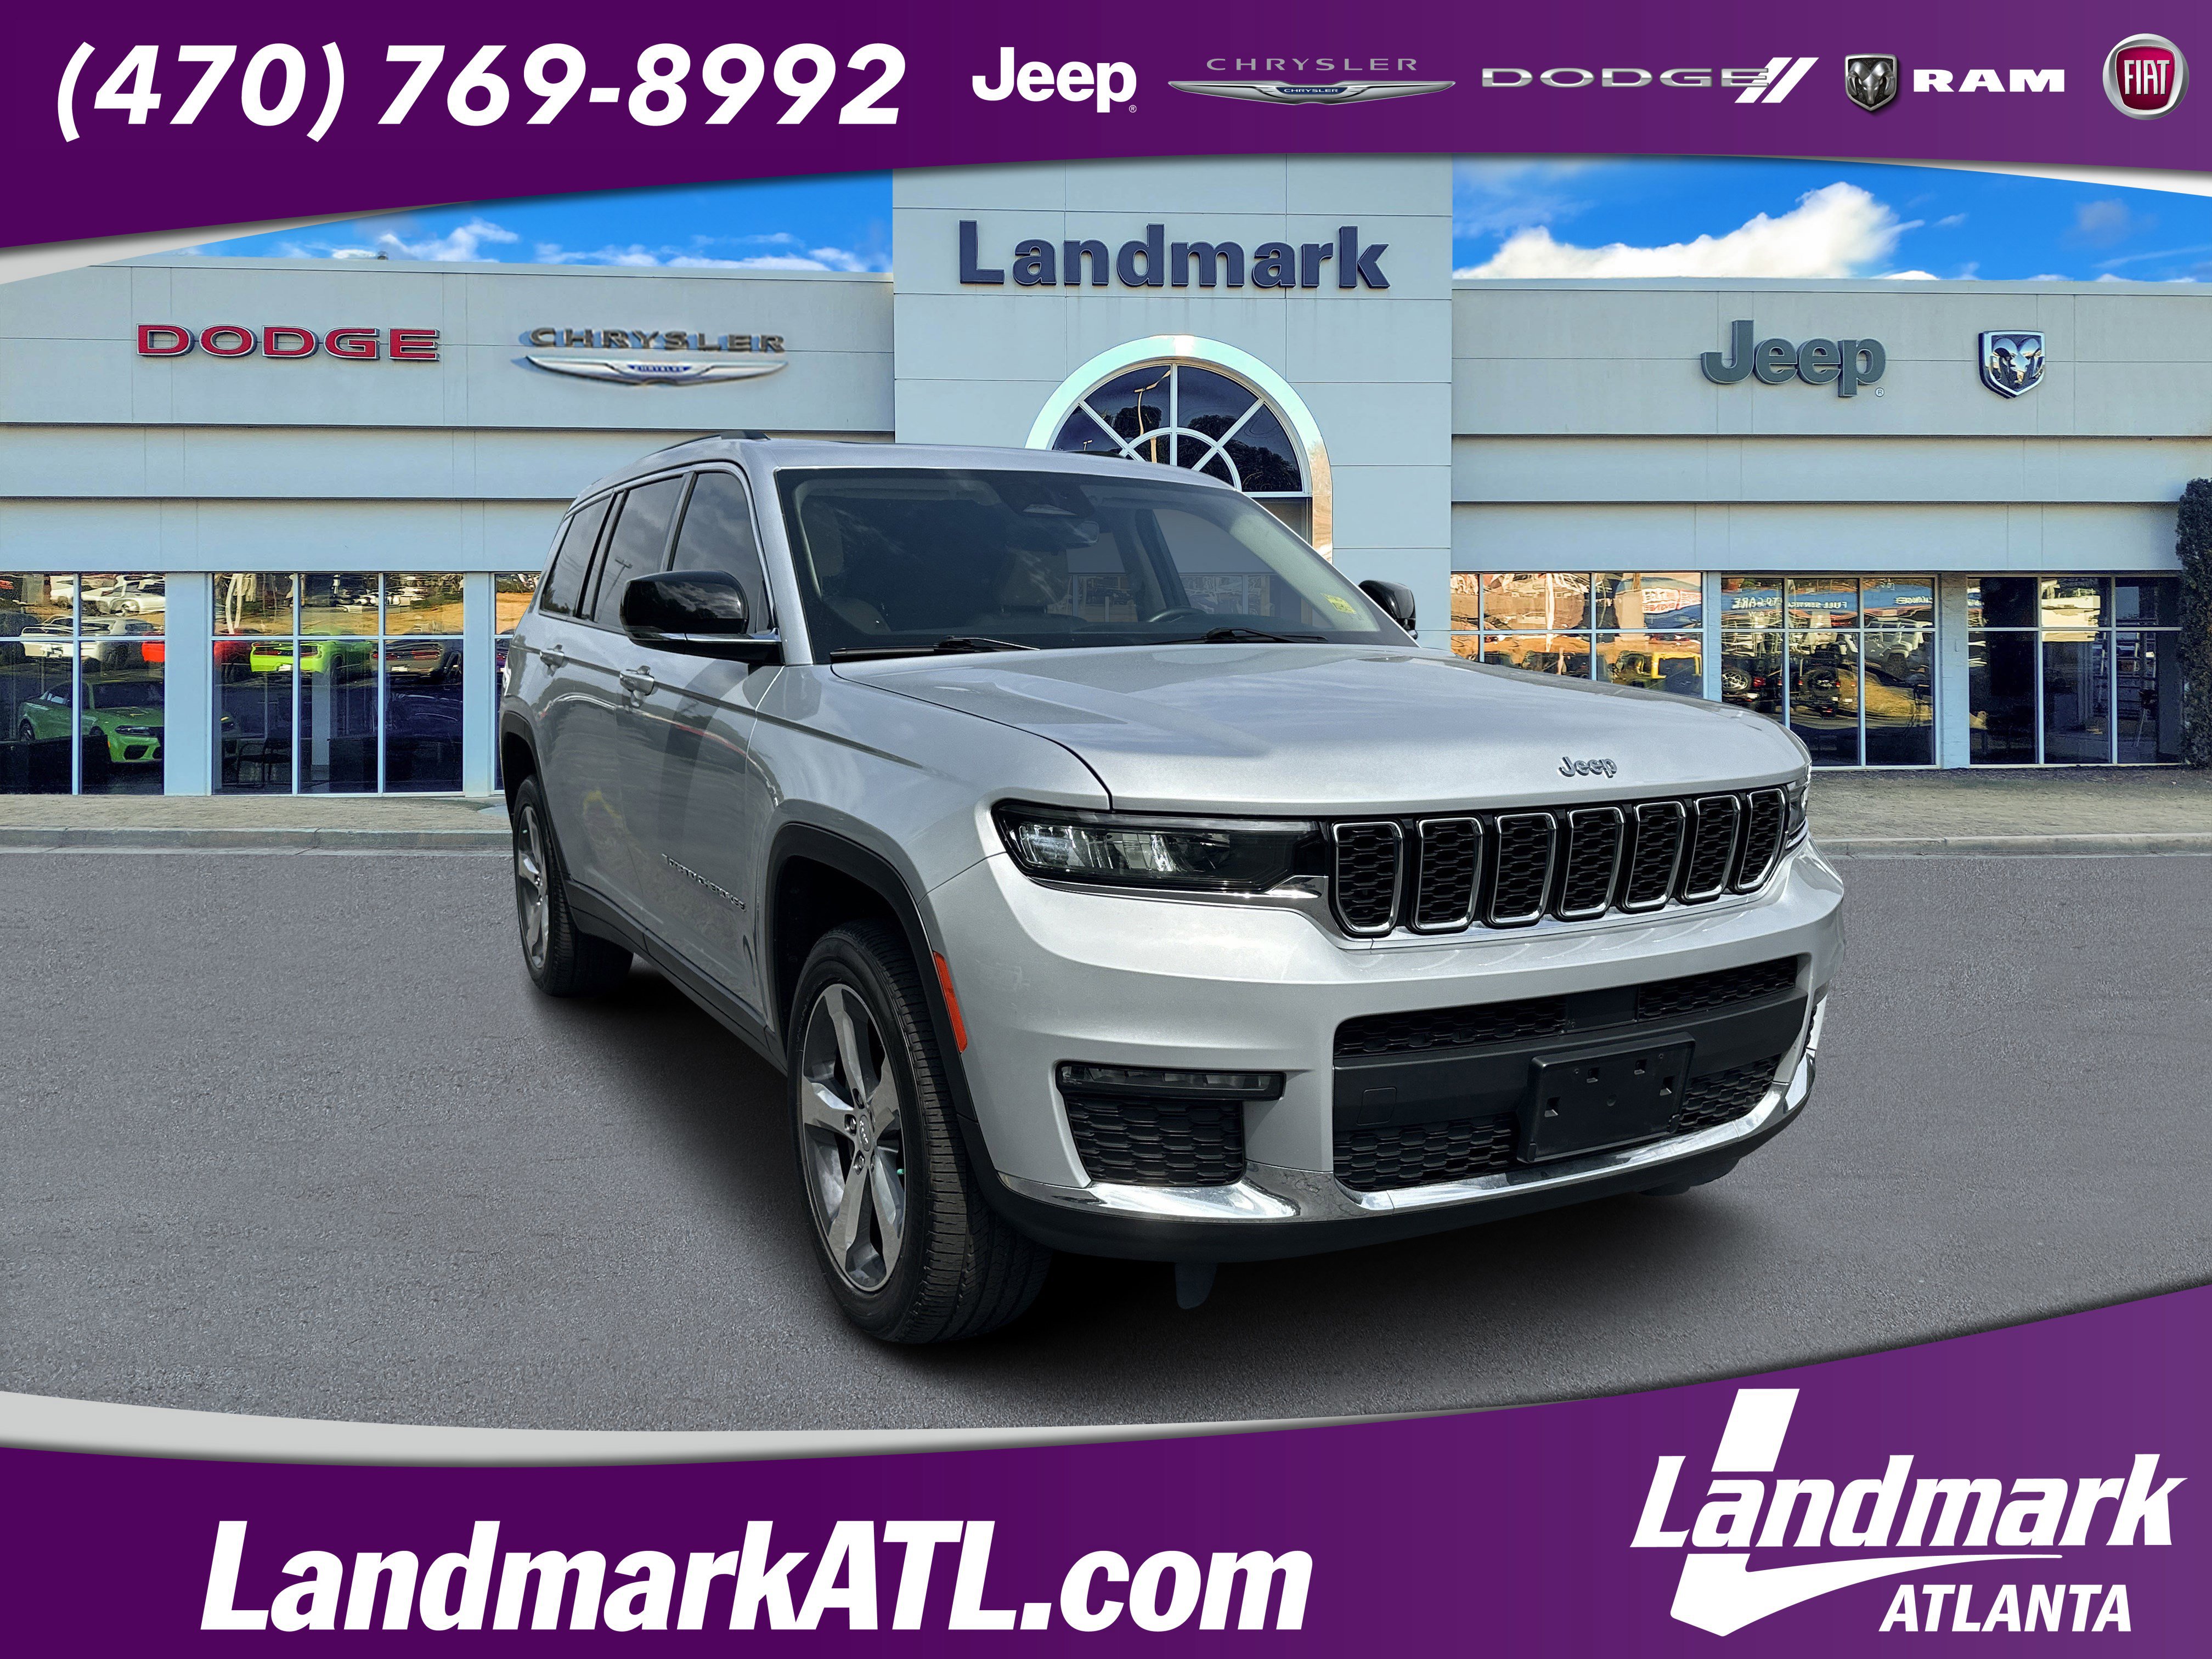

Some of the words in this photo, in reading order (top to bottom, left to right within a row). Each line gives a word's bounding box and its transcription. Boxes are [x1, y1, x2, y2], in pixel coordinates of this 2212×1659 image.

[959, 219, 1390, 289] Landmark
[136, 323, 439, 363] DODGE
[529, 328, 786, 353] CHRYSLER
[1701, 319, 1886, 398] Jeep
[1557, 756, 1617, 778] Jeep
